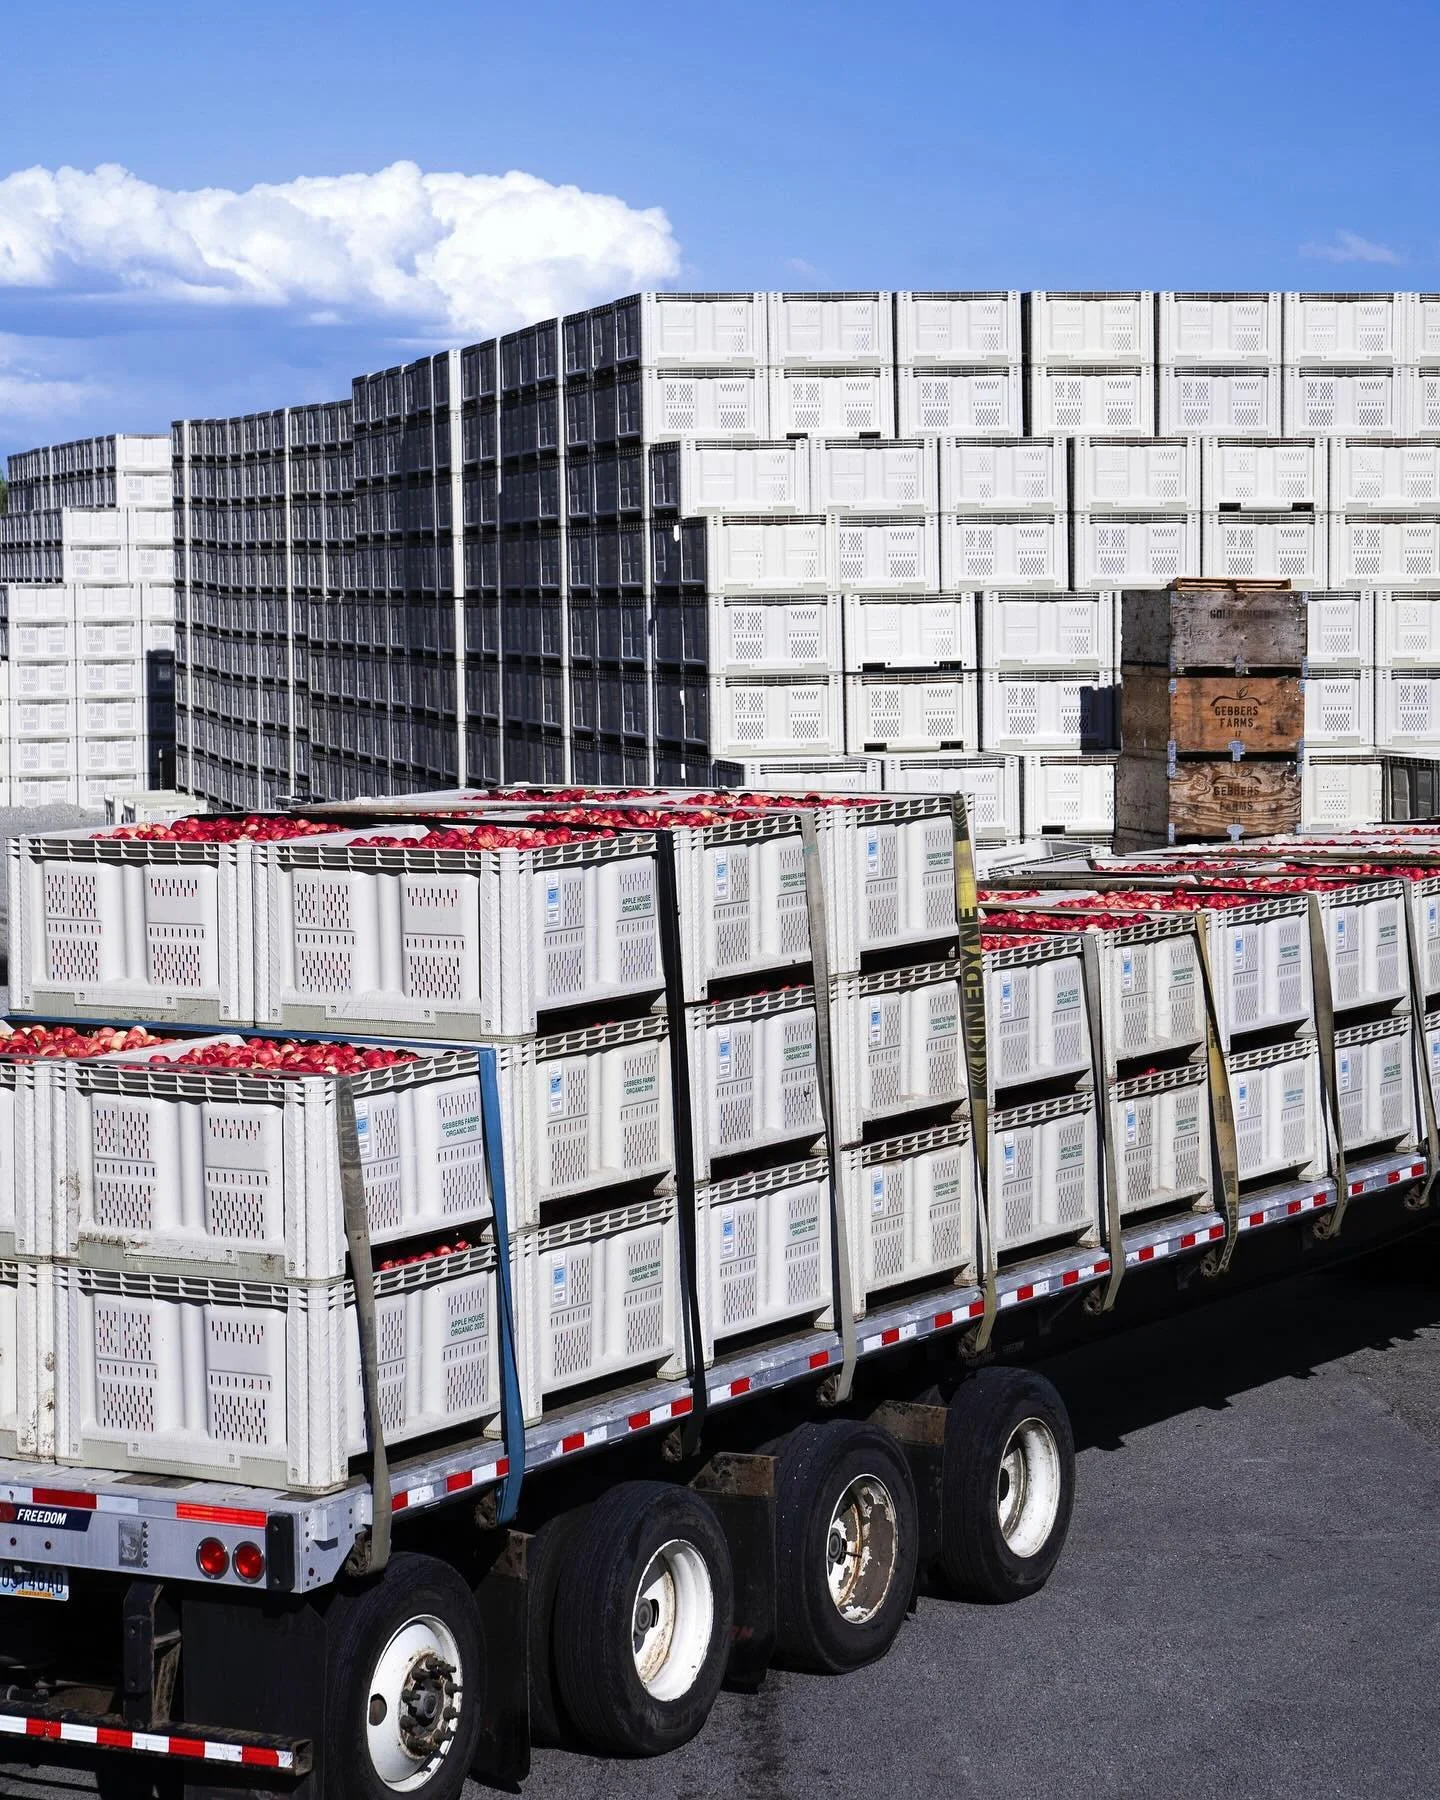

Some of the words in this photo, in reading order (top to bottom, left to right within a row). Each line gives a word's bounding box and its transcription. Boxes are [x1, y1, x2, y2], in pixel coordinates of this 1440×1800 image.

[1215, 705, 1258, 716] GEBBERS
[1220, 717, 1254, 728] FARMS
[1214, 786, 1260, 796] GEBBERS
[622, 897, 635, 905] APPLE
[637, 894, 651, 903] HOUSE
[622, 904, 641, 913] ORGANIC
[959, 906, 985, 1058] KINEDYNE
[783, 1046, 800, 1054] GEBBERS
[786, 1053, 801, 1061] ORGANIC
[623, 1079, 641, 1087] GEBBERS
[642, 1076, 655, 1084] FARMS
[625, 1086, 643, 1095] ORGANIC
[441, 1119, 464, 1130] GEBBERS
[465, 1115, 479, 1124] FARMS
[445, 1126, 467, 1137] ORGANIC
[790, 1221, 805, 1230] GEBBERS
[792, 1227, 807, 1236] ORGANIC
[628, 1265, 647, 1276] GEBBERS
[648, 1261, 660, 1269] FARMS
[631, 1272, 649, 1283] ORGANIC
[450, 1317, 467, 1328] APPLE
[467, 1313, 484, 1323] HOUSE
[450, 1324, 473, 1337] ORGANIC
[17, 1508, 67, 1525] FREEDOM
